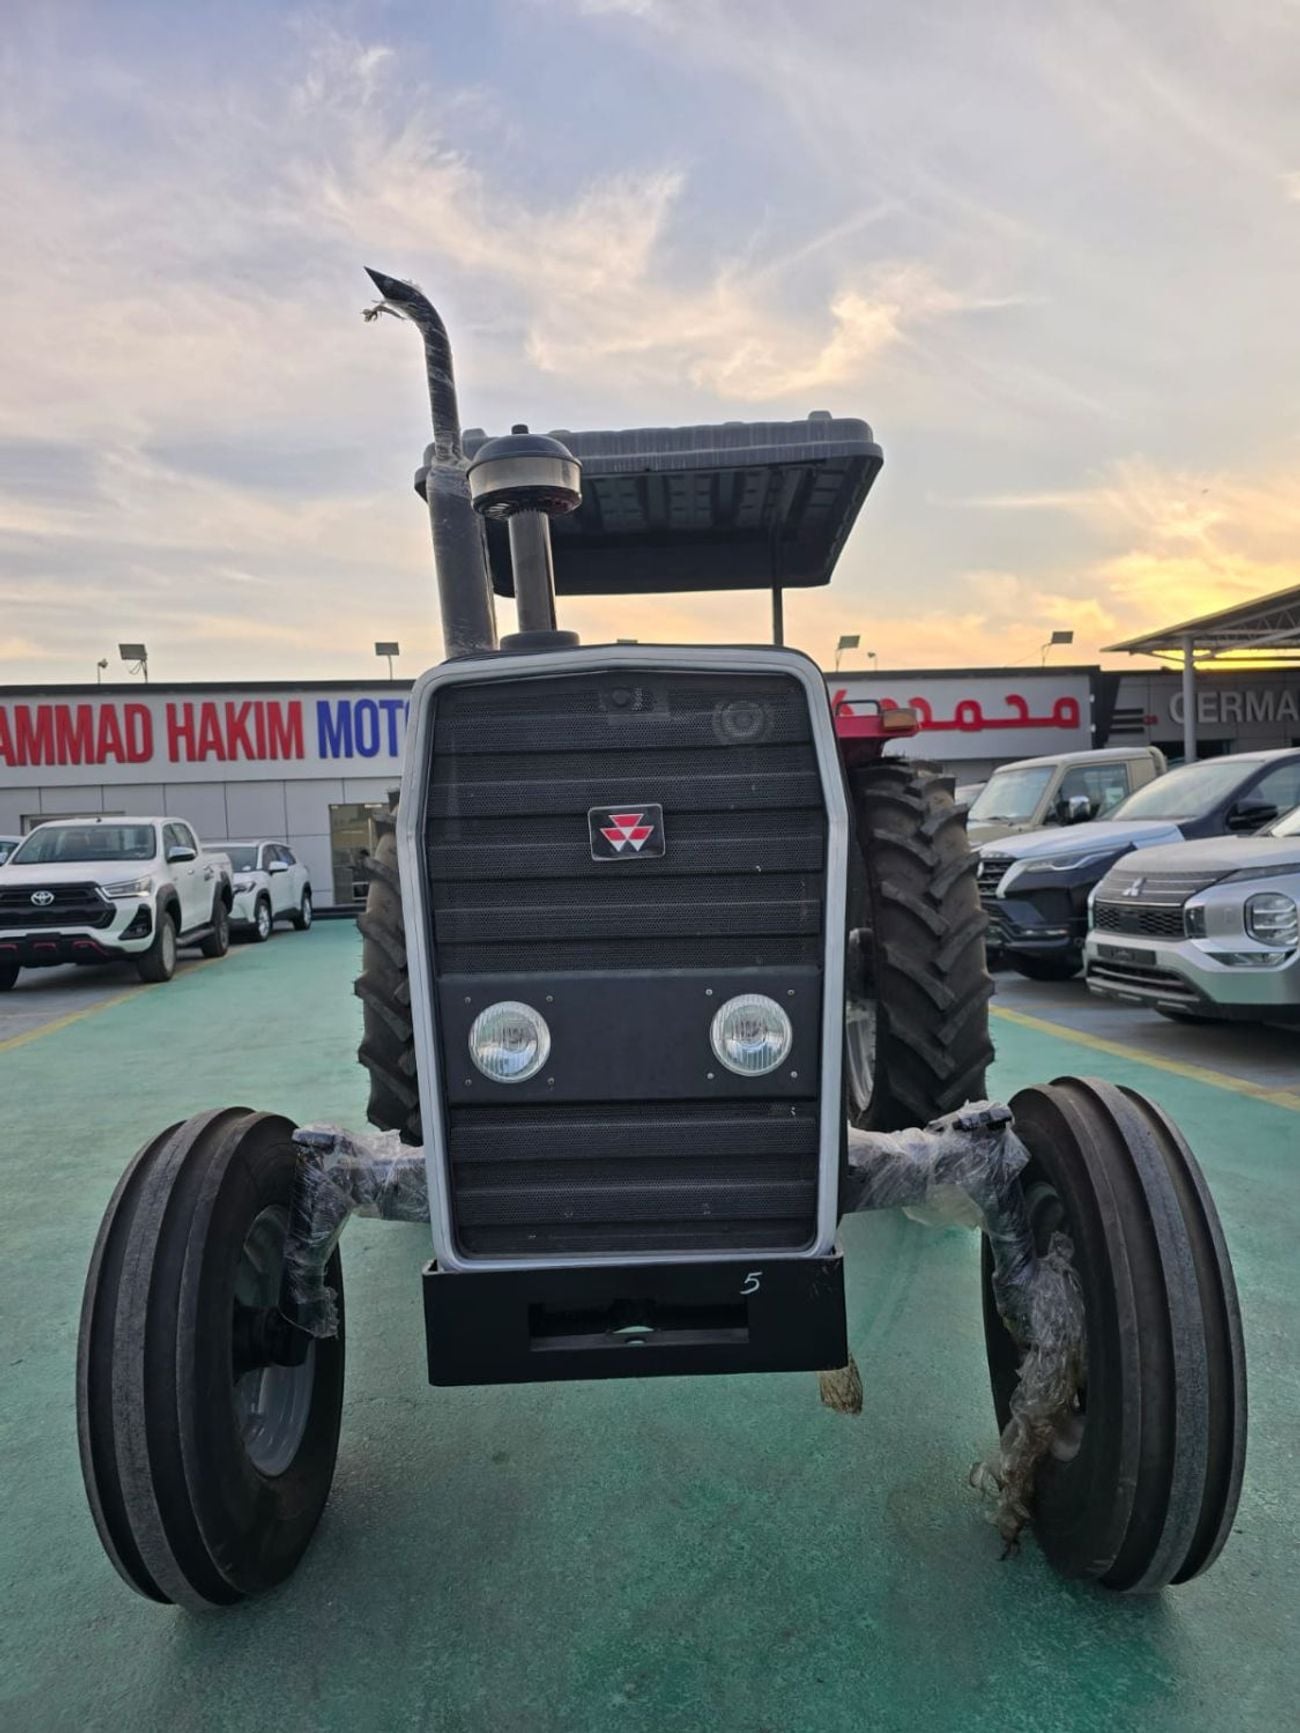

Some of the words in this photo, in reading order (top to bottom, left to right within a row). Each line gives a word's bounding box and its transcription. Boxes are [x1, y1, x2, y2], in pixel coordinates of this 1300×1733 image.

[166, 701, 305, 762] HAKIM
[316, 698, 410, 760] MOT
[740, 1271, 763, 1295] 5
